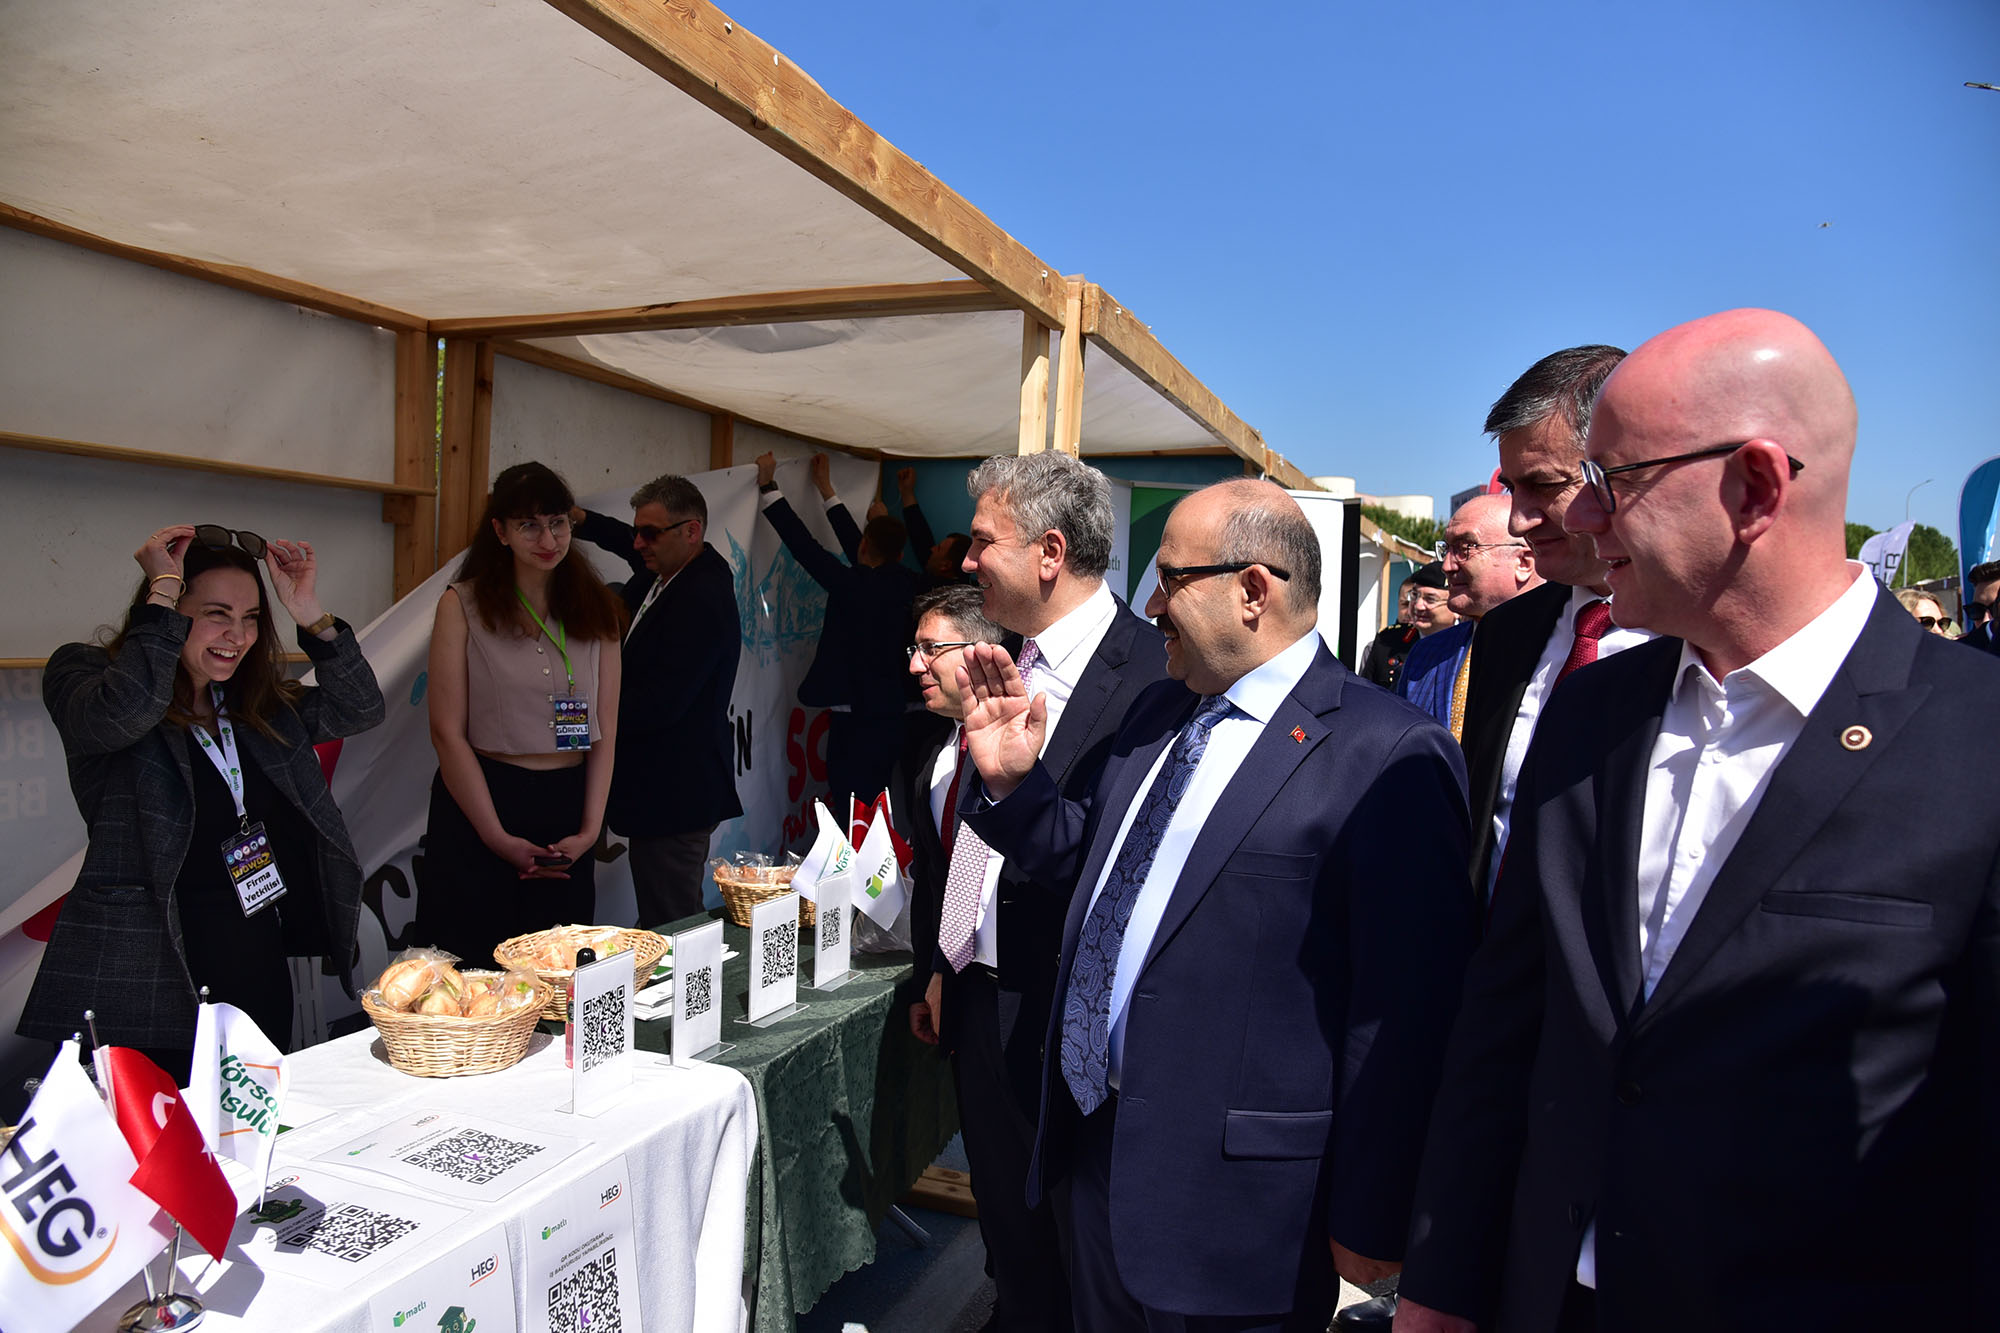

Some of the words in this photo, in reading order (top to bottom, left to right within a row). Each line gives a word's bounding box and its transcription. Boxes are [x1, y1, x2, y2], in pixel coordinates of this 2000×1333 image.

[244, 877, 281, 904] Yetkilisi
[245, 871, 271, 890] Firma
[0, 1116, 95, 1257] HEG
[600, 1184, 619, 1204] HEG
[471, 1257, 495, 1281] HEG
[405, 1300, 427, 1320] matlı
